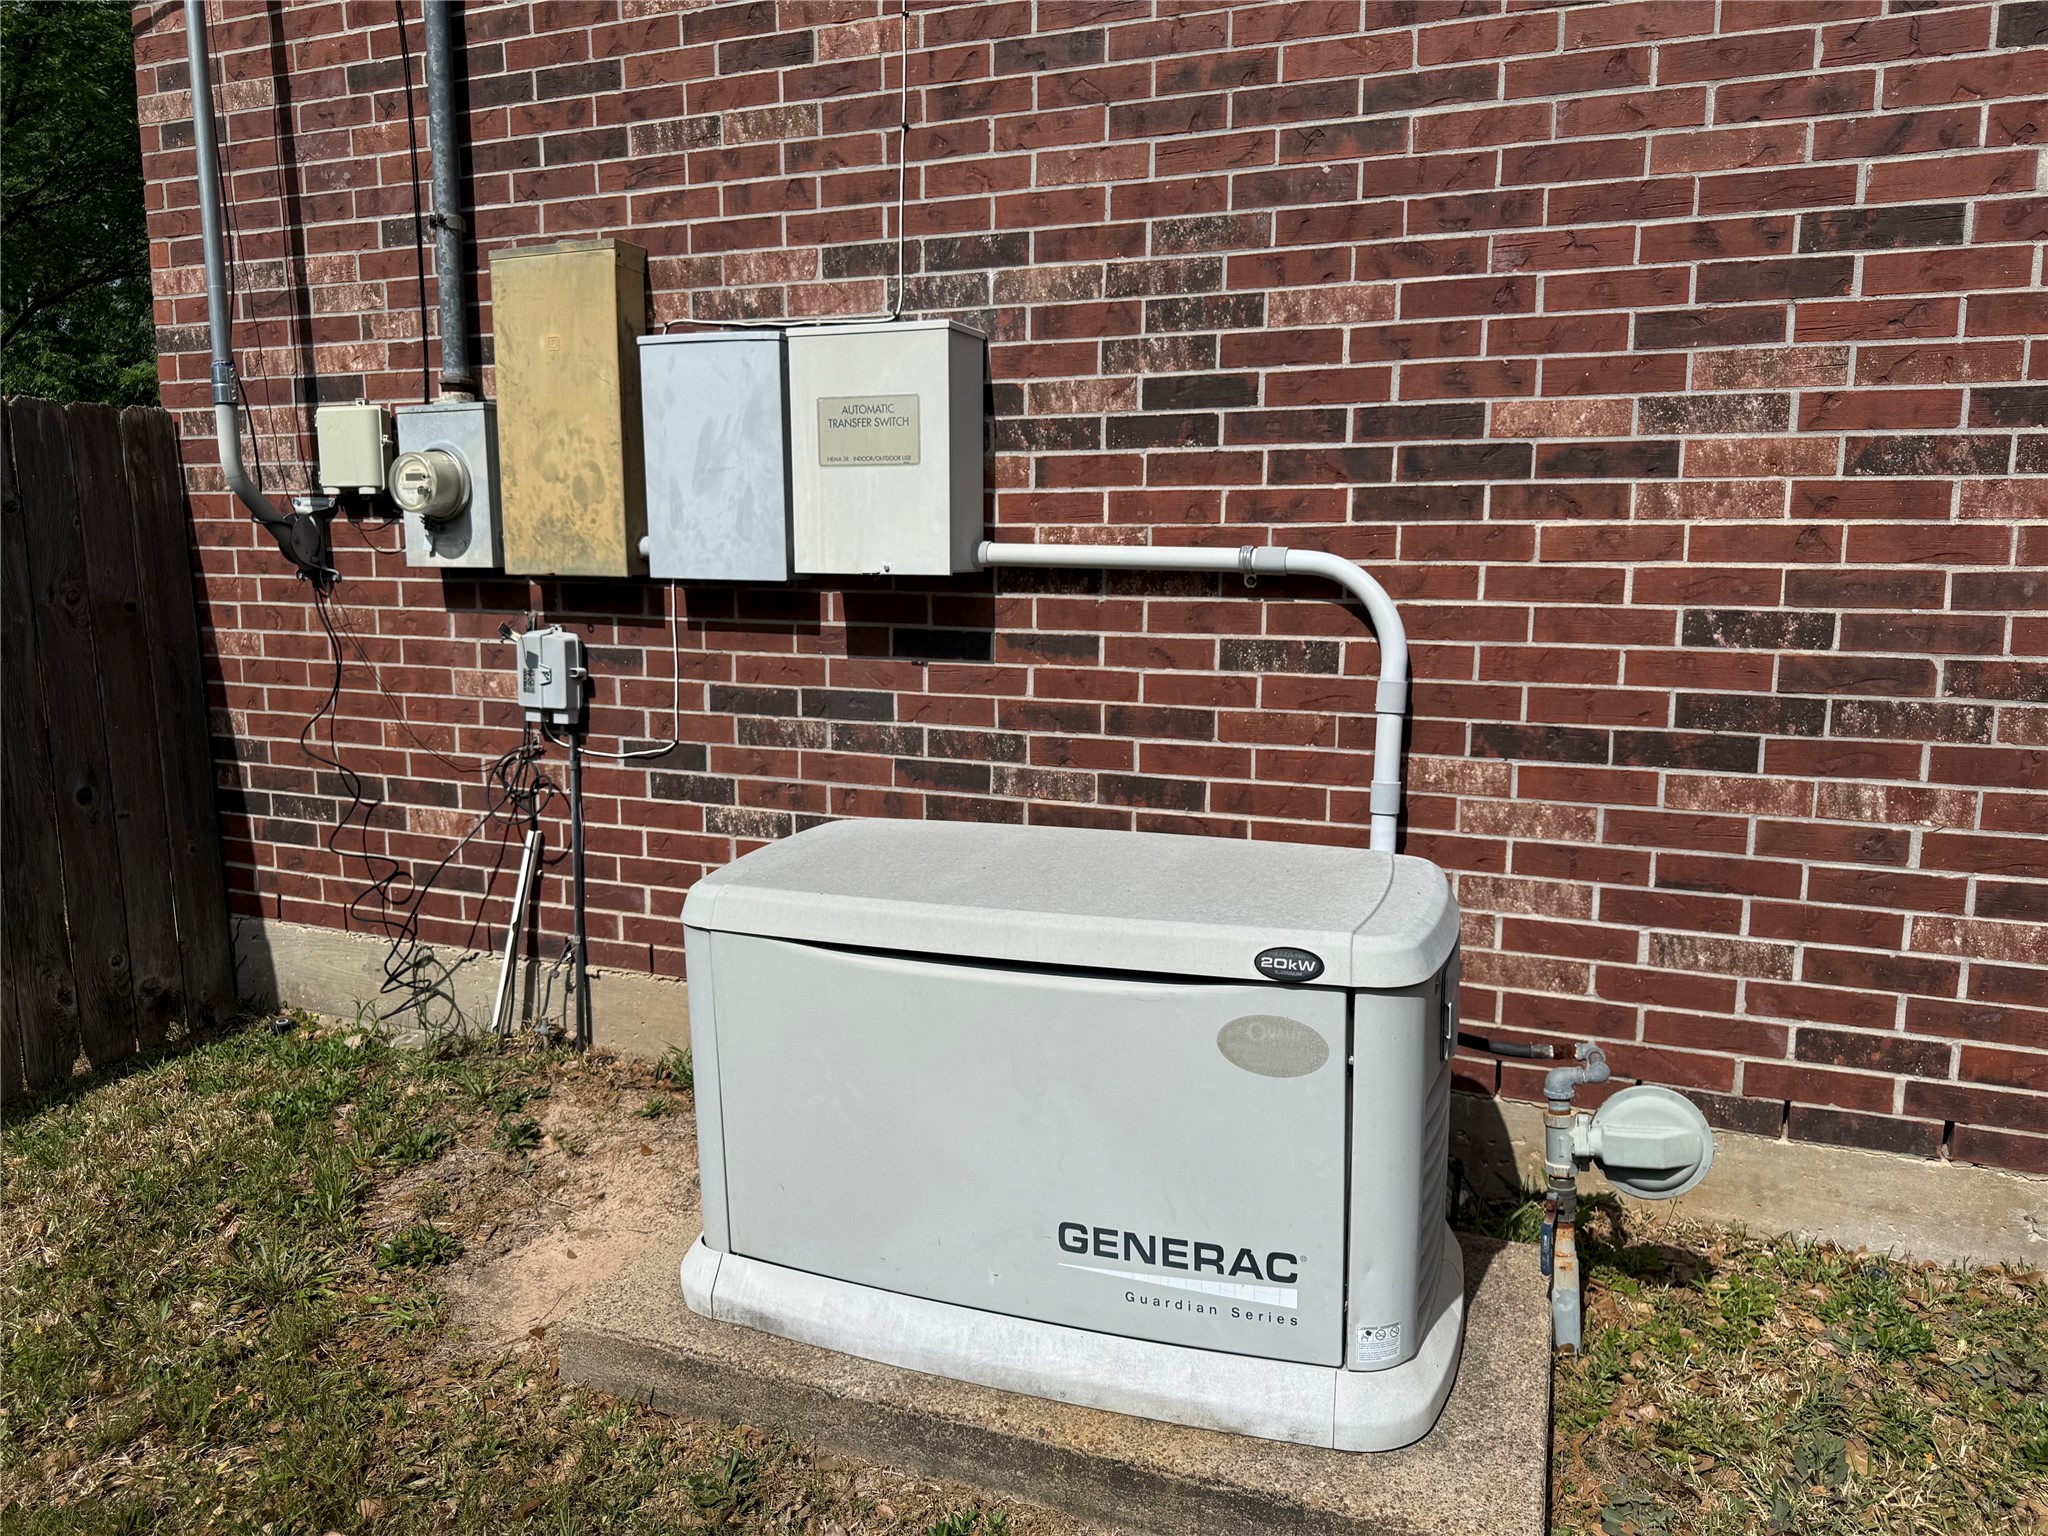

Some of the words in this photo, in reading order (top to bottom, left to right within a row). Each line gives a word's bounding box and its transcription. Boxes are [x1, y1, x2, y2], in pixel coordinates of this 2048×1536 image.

[841, 403, 894, 415] AUTOMATIC
[828, 417, 872, 428] TRANSFER
[874, 416, 909, 427] SWITCH
[1260, 956, 1316, 972] 20kW
[1058, 1221, 1298, 1284] GENERAC
[1125, 1291, 1218, 1316] Guardian
[1231, 1307, 1298, 1326] Series
